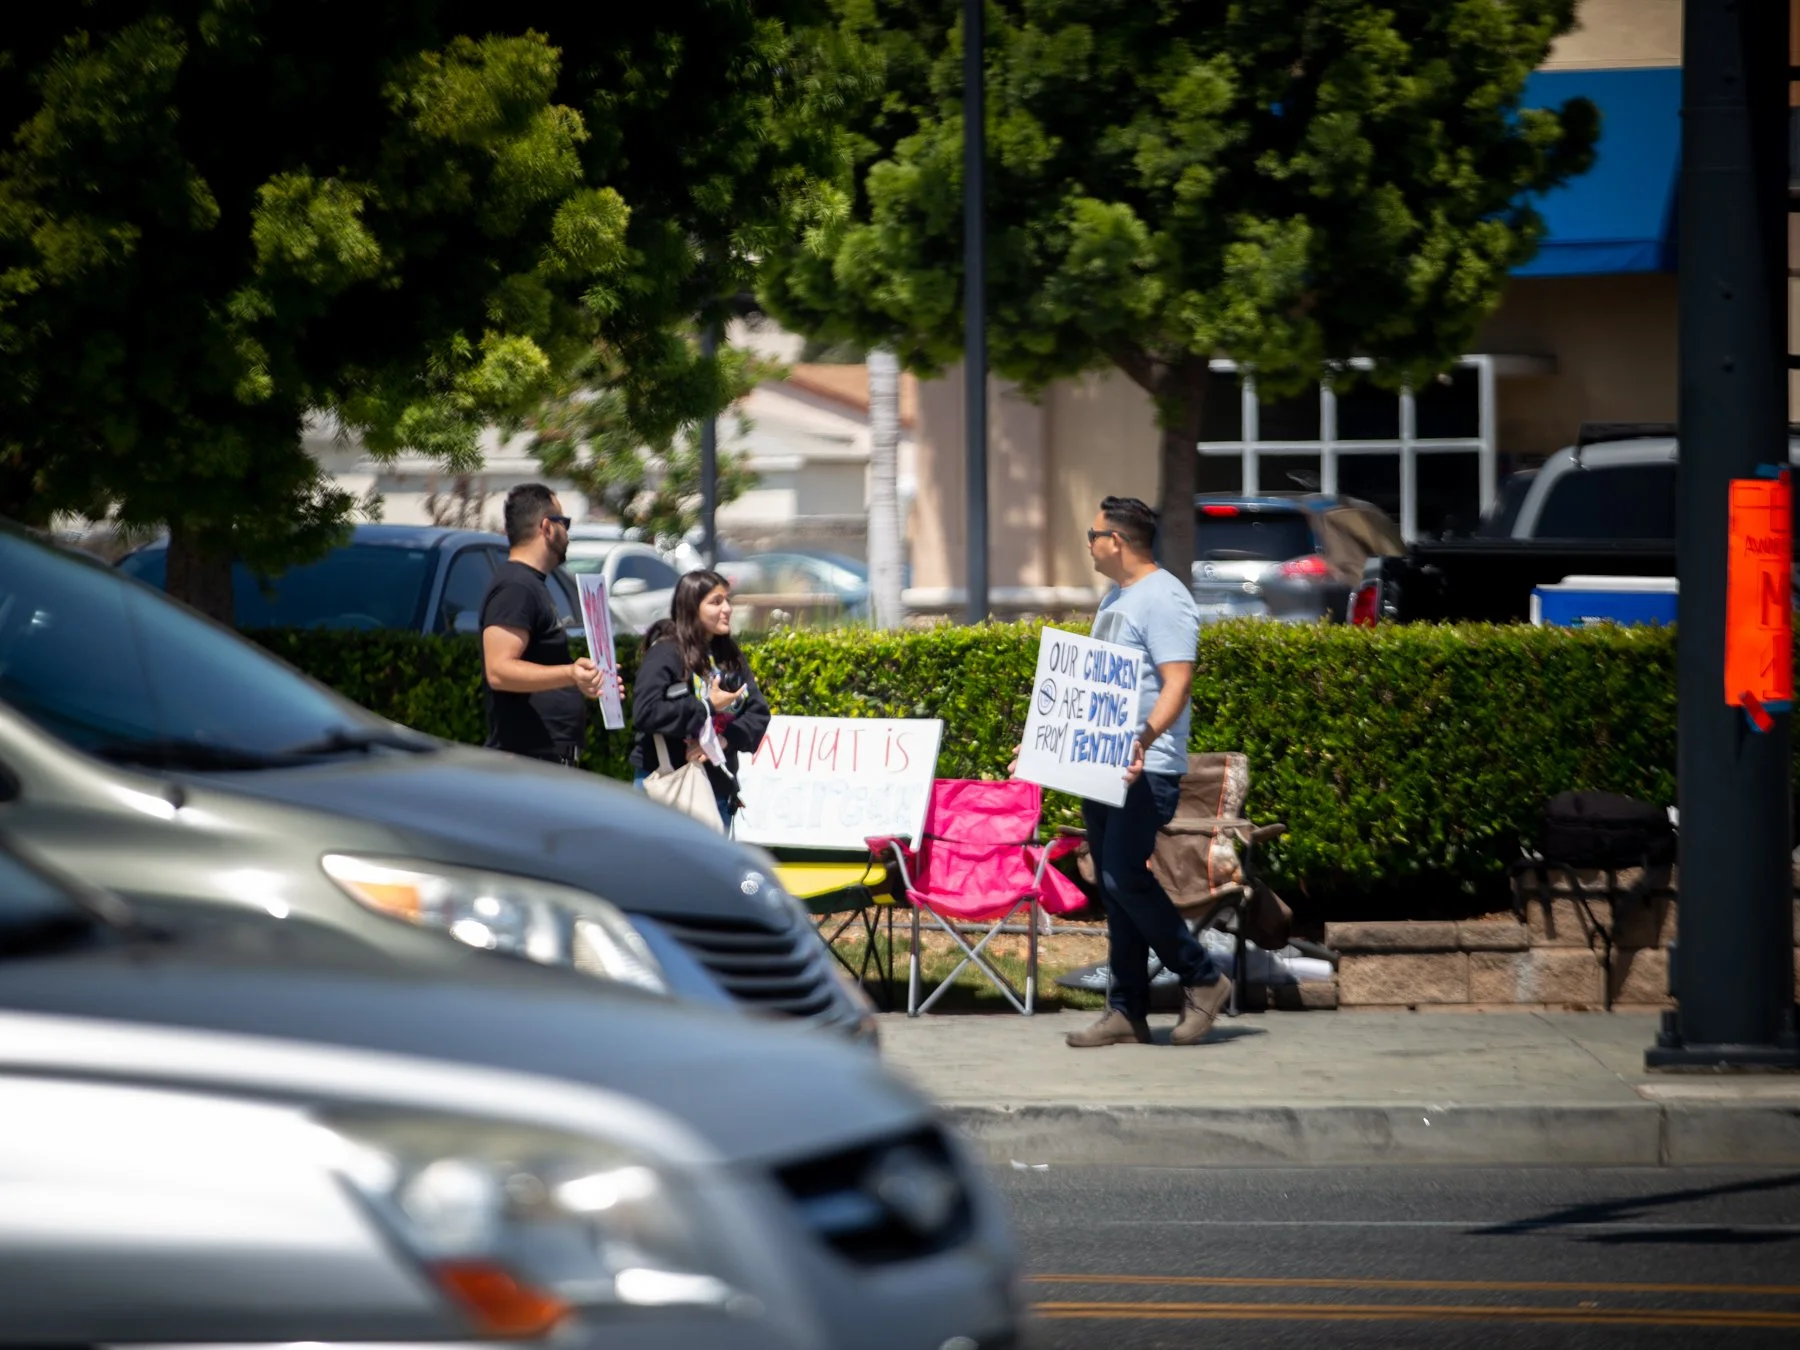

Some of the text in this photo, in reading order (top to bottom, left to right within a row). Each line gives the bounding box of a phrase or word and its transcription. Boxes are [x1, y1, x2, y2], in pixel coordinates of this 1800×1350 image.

[1049, 641, 1078, 677] OUR
[1058, 687, 1085, 720] ARE
[1035, 722, 1068, 764] FROM
